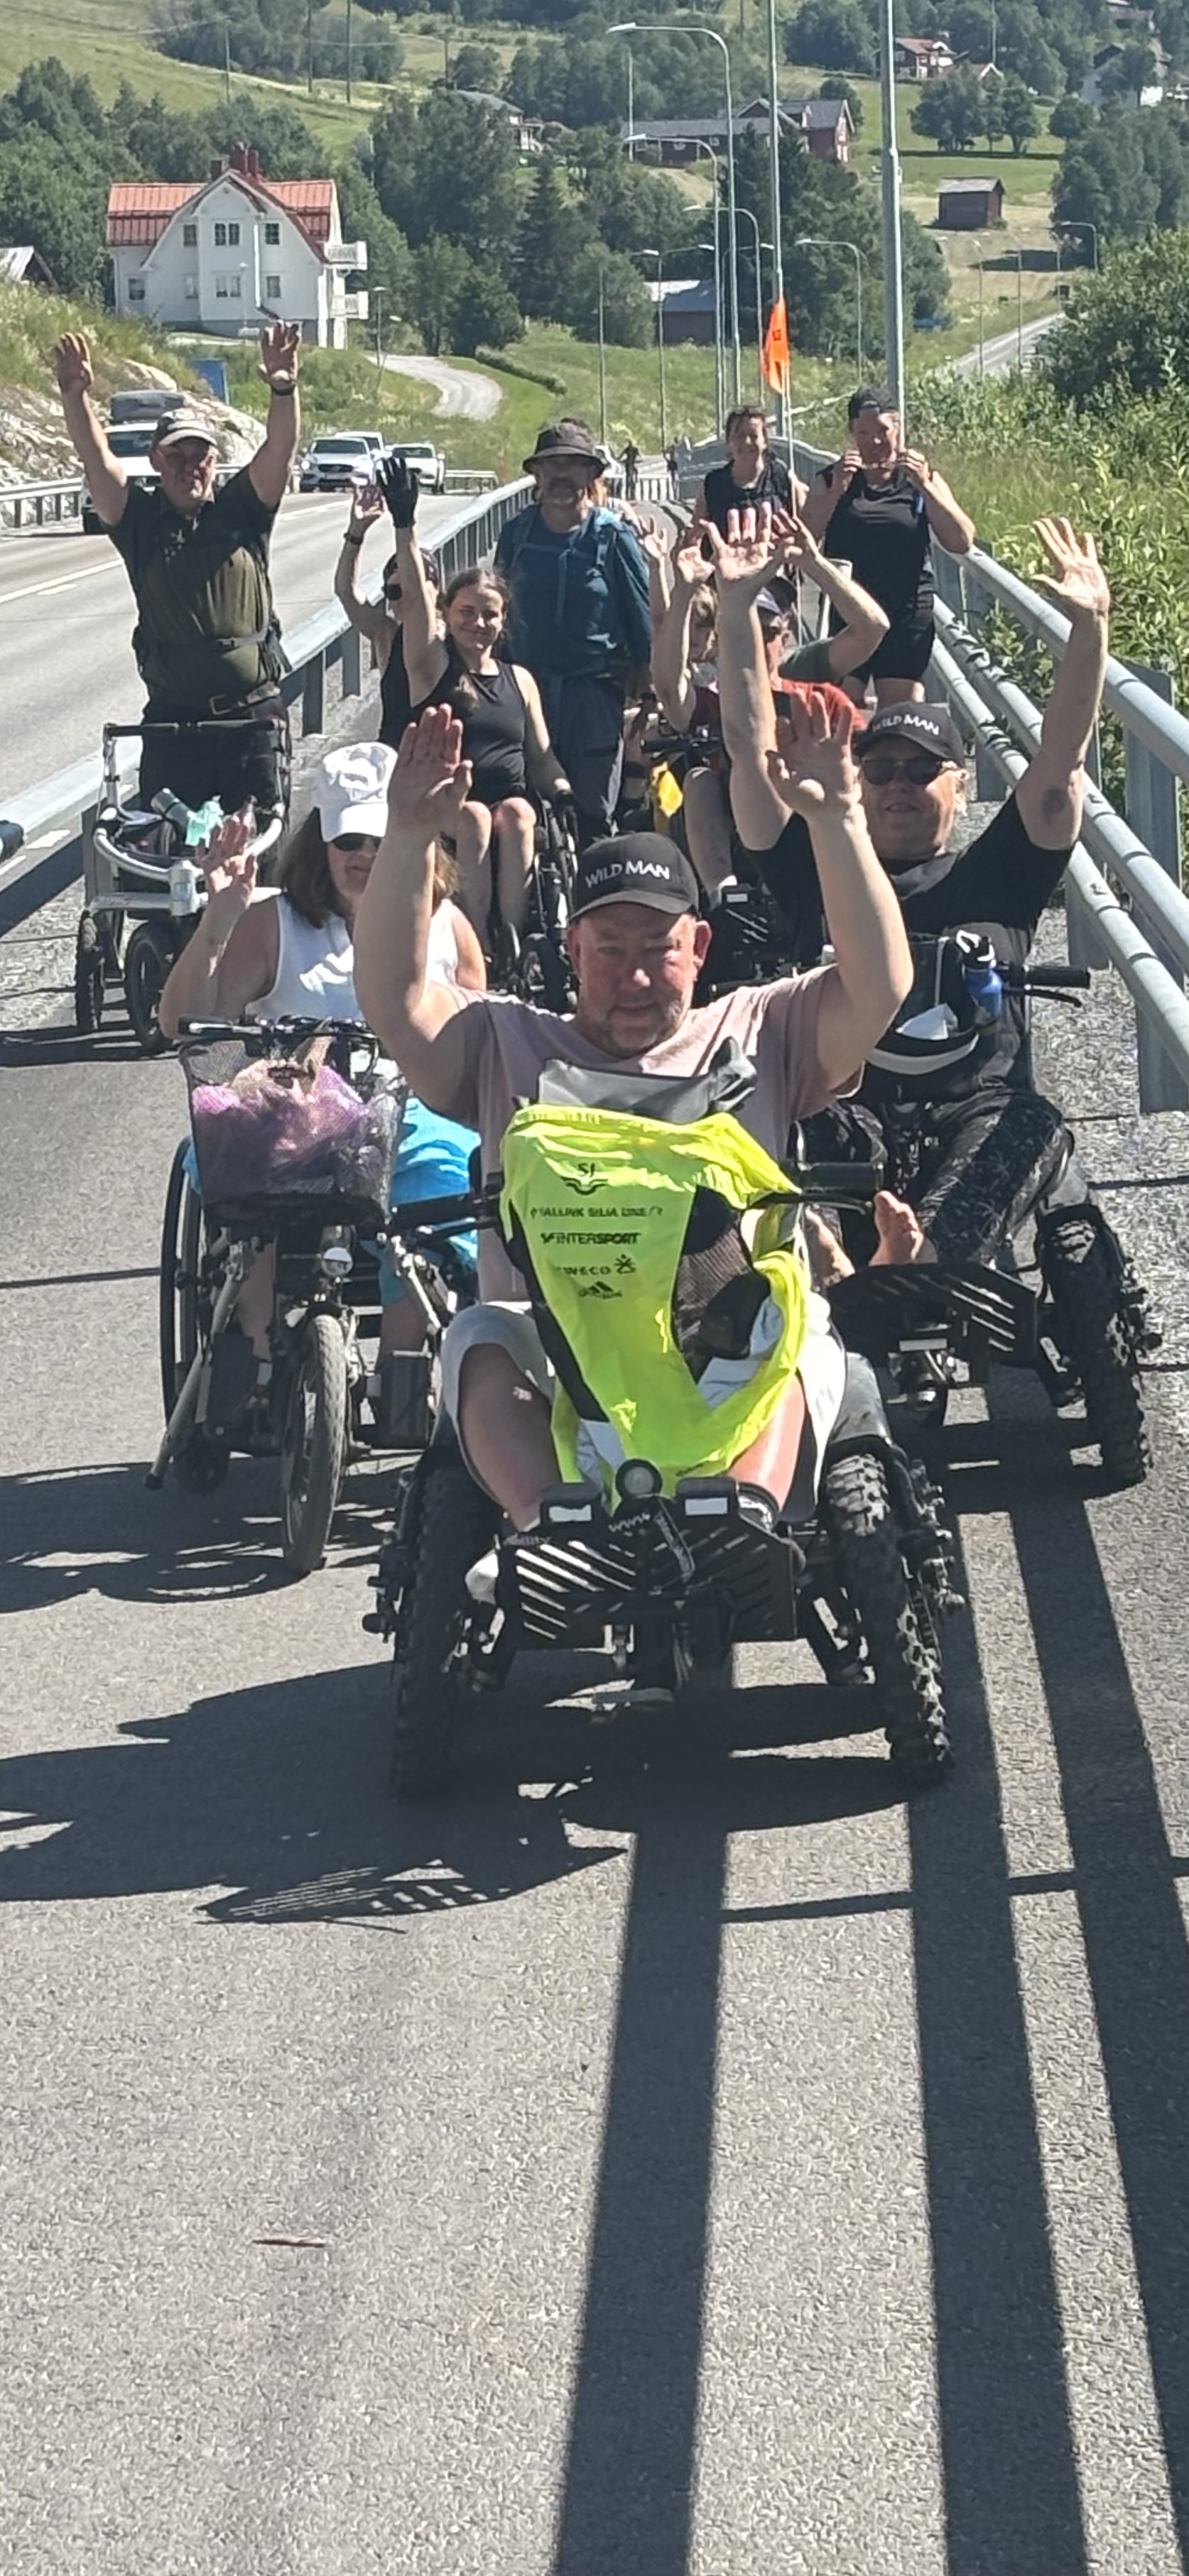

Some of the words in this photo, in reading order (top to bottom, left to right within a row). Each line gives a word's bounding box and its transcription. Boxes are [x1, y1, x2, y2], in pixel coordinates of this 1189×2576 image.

[903, 714, 940, 736] MAN
[585, 863, 622, 888] WILD
[625, 860, 670, 880] MAN
